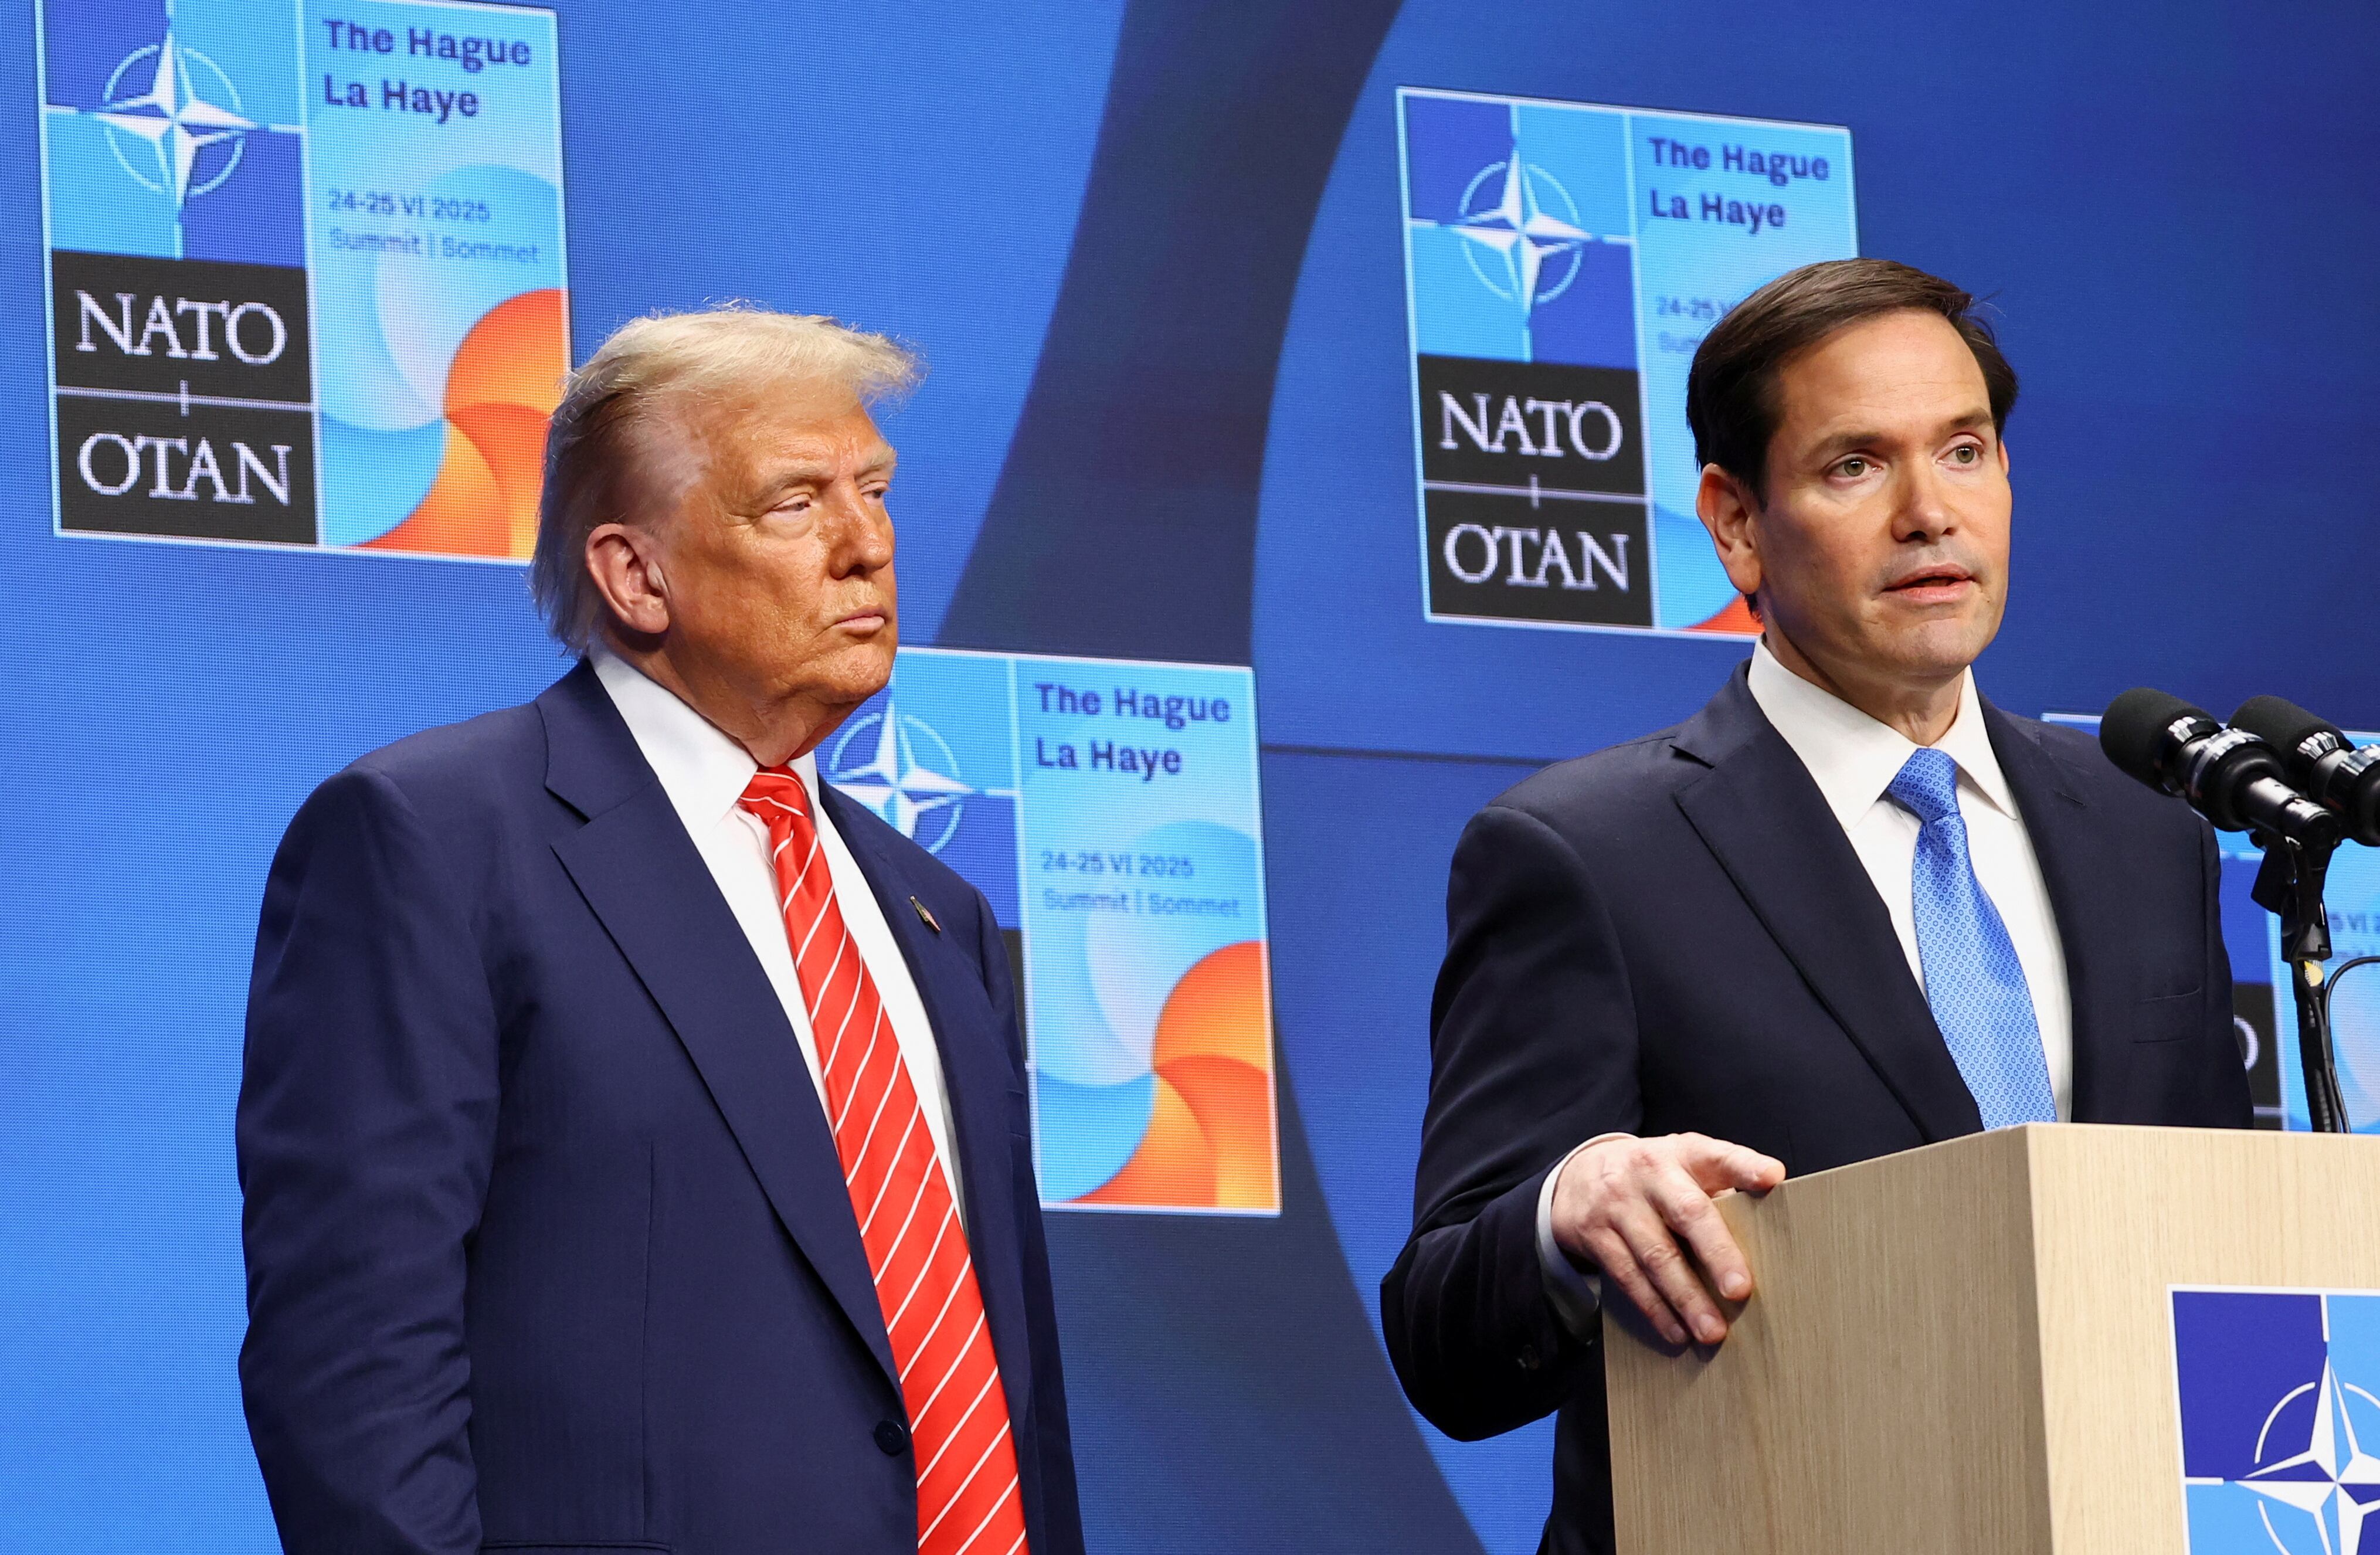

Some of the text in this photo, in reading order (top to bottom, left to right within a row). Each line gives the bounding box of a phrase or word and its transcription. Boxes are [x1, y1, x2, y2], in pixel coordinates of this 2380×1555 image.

[324, 20, 531, 73] The Hague
[324, 74, 479, 125] La Haye
[1648, 137, 1828, 186] The Hague
[328, 189, 491, 223] 24-25 VI 2025
[1650, 188, 1785, 235] La Haye
[329, 228, 421, 254] Summit
[442, 236, 539, 264] Sommet
[75, 289, 287, 365] NATO
[1656, 296, 1713, 319] 24-25
[1439, 389, 1623, 461] NATO
[77, 433, 292, 506] OTAN
[1444, 524, 1629, 592] OTAN
[1035, 684, 1230, 729] The Hague
[1036, 737, 1182, 783] La Haye
[1042, 850, 1194, 878] 24-25 VI 2025
[1042, 888, 1128, 912] Summit
[1147, 892, 1239, 917] Sommet
